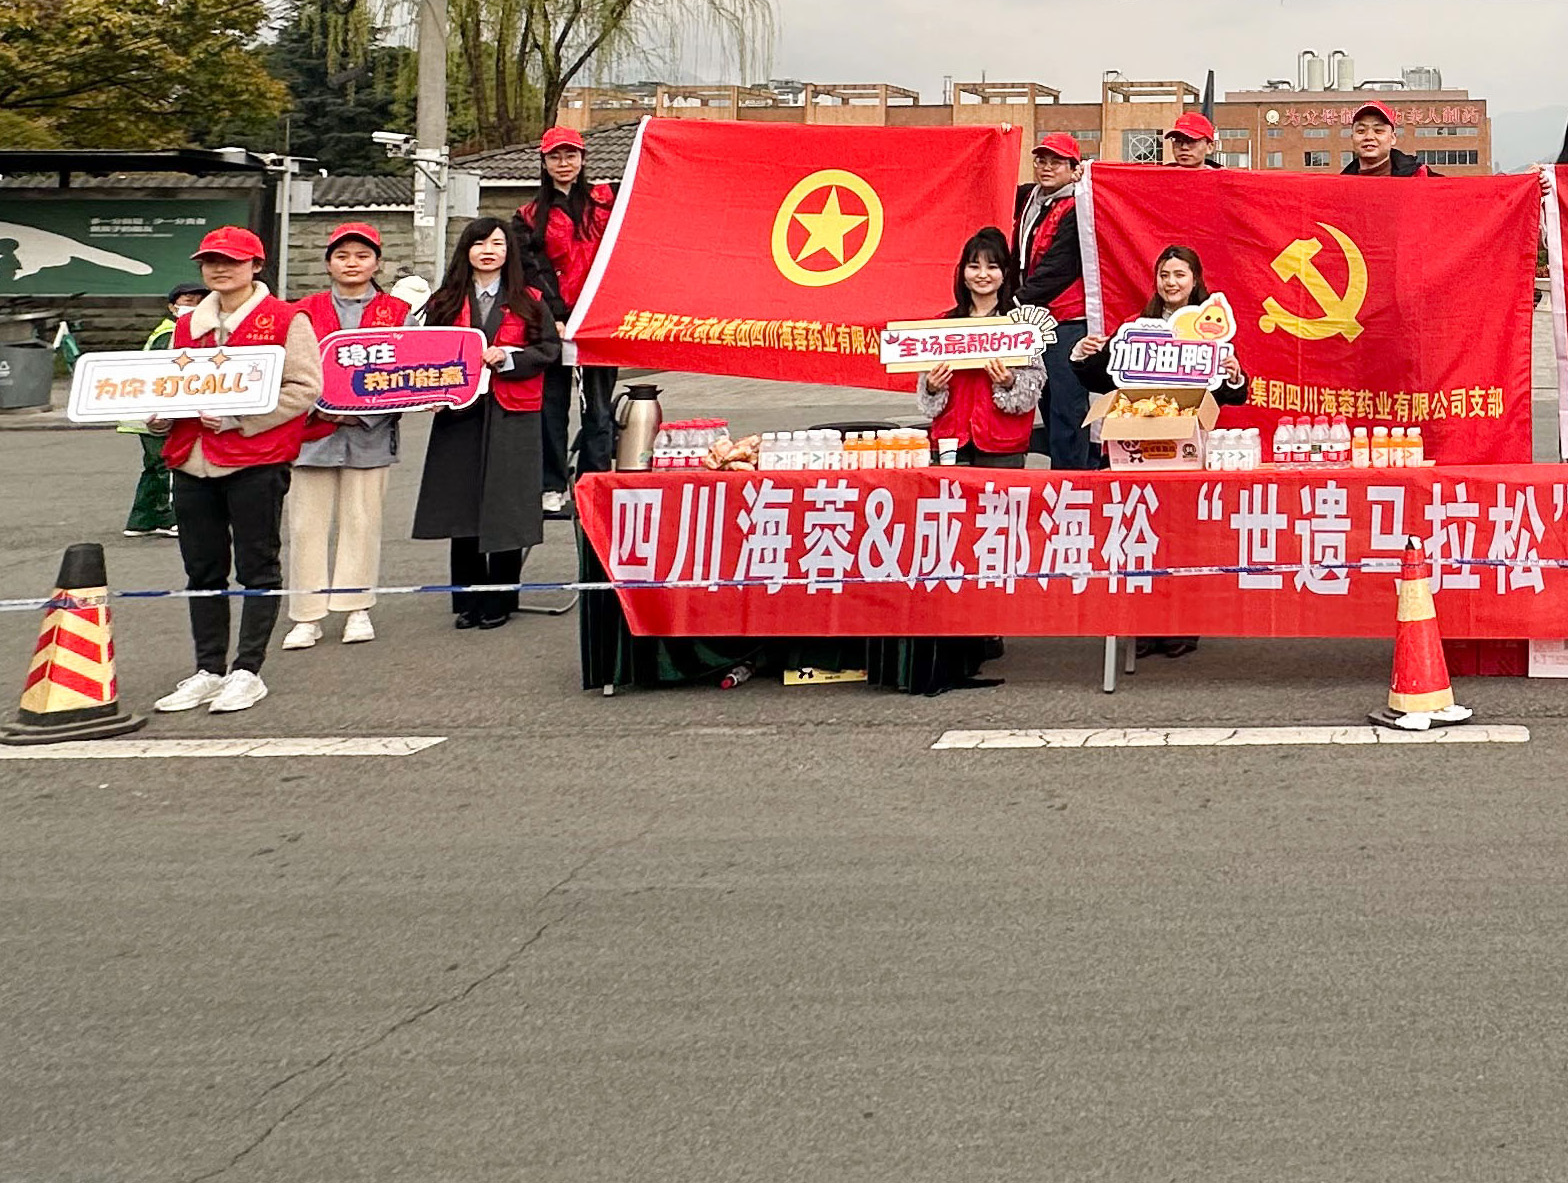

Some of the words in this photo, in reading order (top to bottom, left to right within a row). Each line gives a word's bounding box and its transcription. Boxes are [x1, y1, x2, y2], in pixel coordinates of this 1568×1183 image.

[337, 343, 397, 366] 稳住
[897, 330, 1035, 357] 全场最靓的仔
[363, 366, 466, 391] 我们能赢
[1246, 375, 1504, 423] 集团四川海蓉药业有限公司支部
[609, 478, 1160, 595] 四川海蓉&成都海裕
